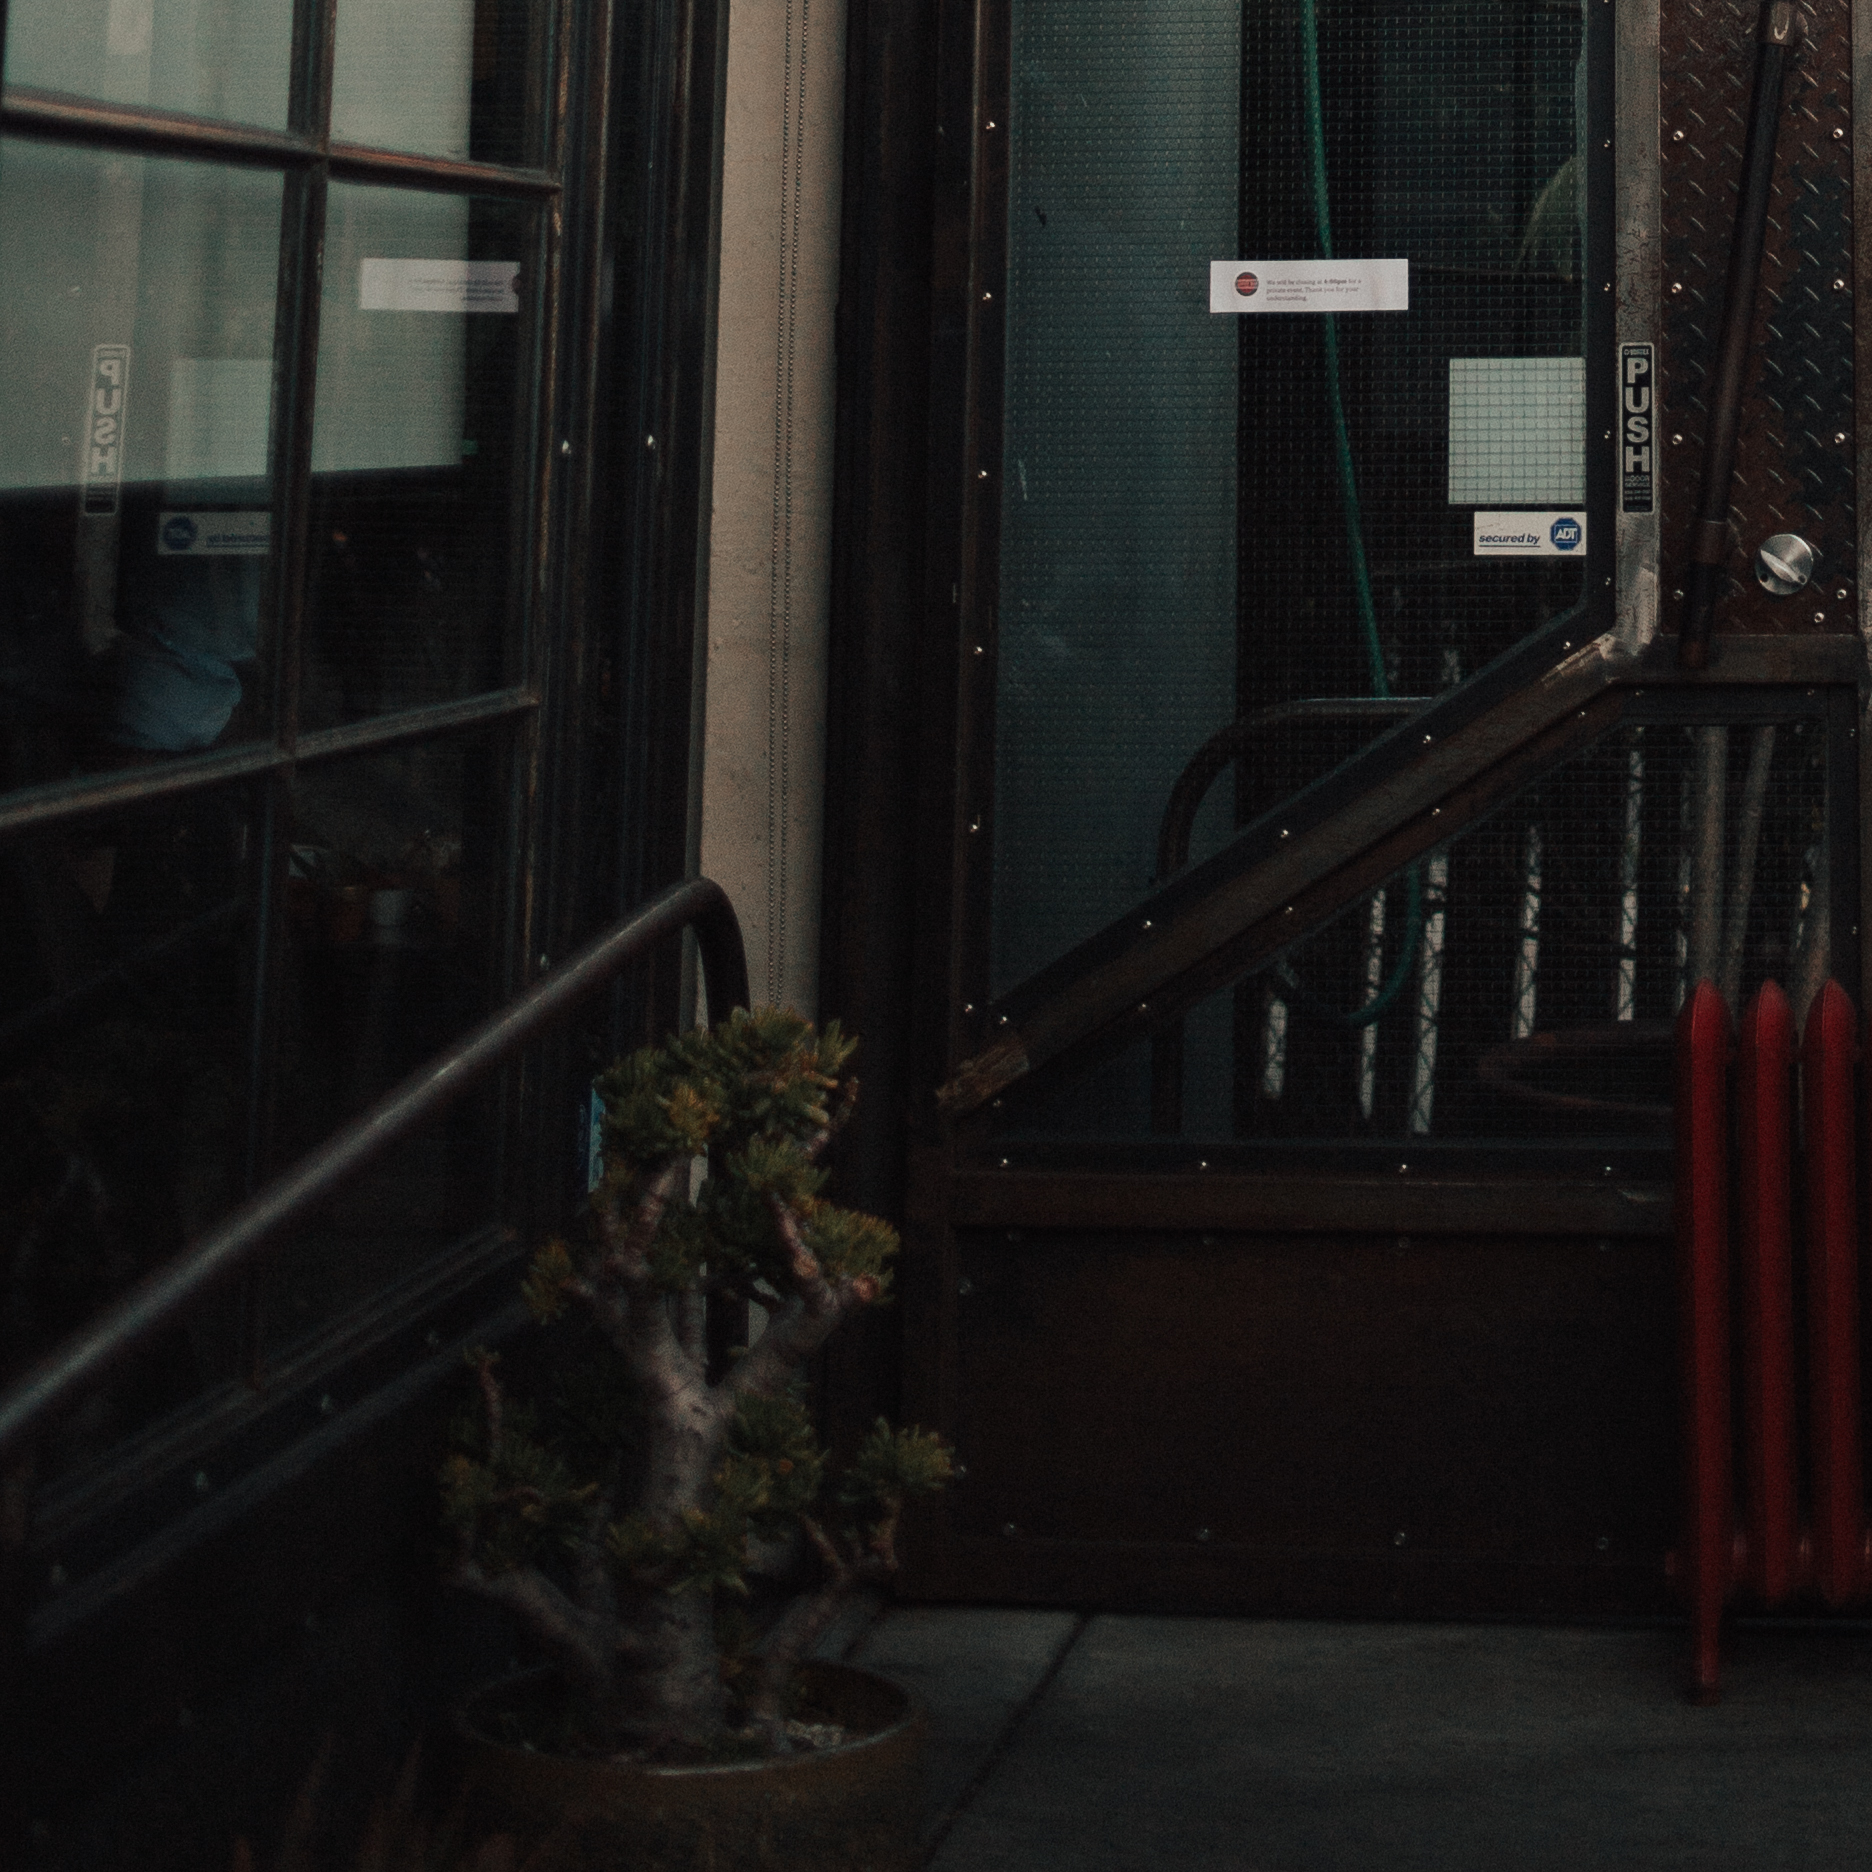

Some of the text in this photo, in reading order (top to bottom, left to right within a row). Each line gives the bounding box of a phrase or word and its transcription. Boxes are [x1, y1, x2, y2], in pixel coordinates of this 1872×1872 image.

[1624, 357, 1651, 474] PUSH
[1478, 533, 1541, 545] secured by
[1555, 527, 1578, 540] ADT
